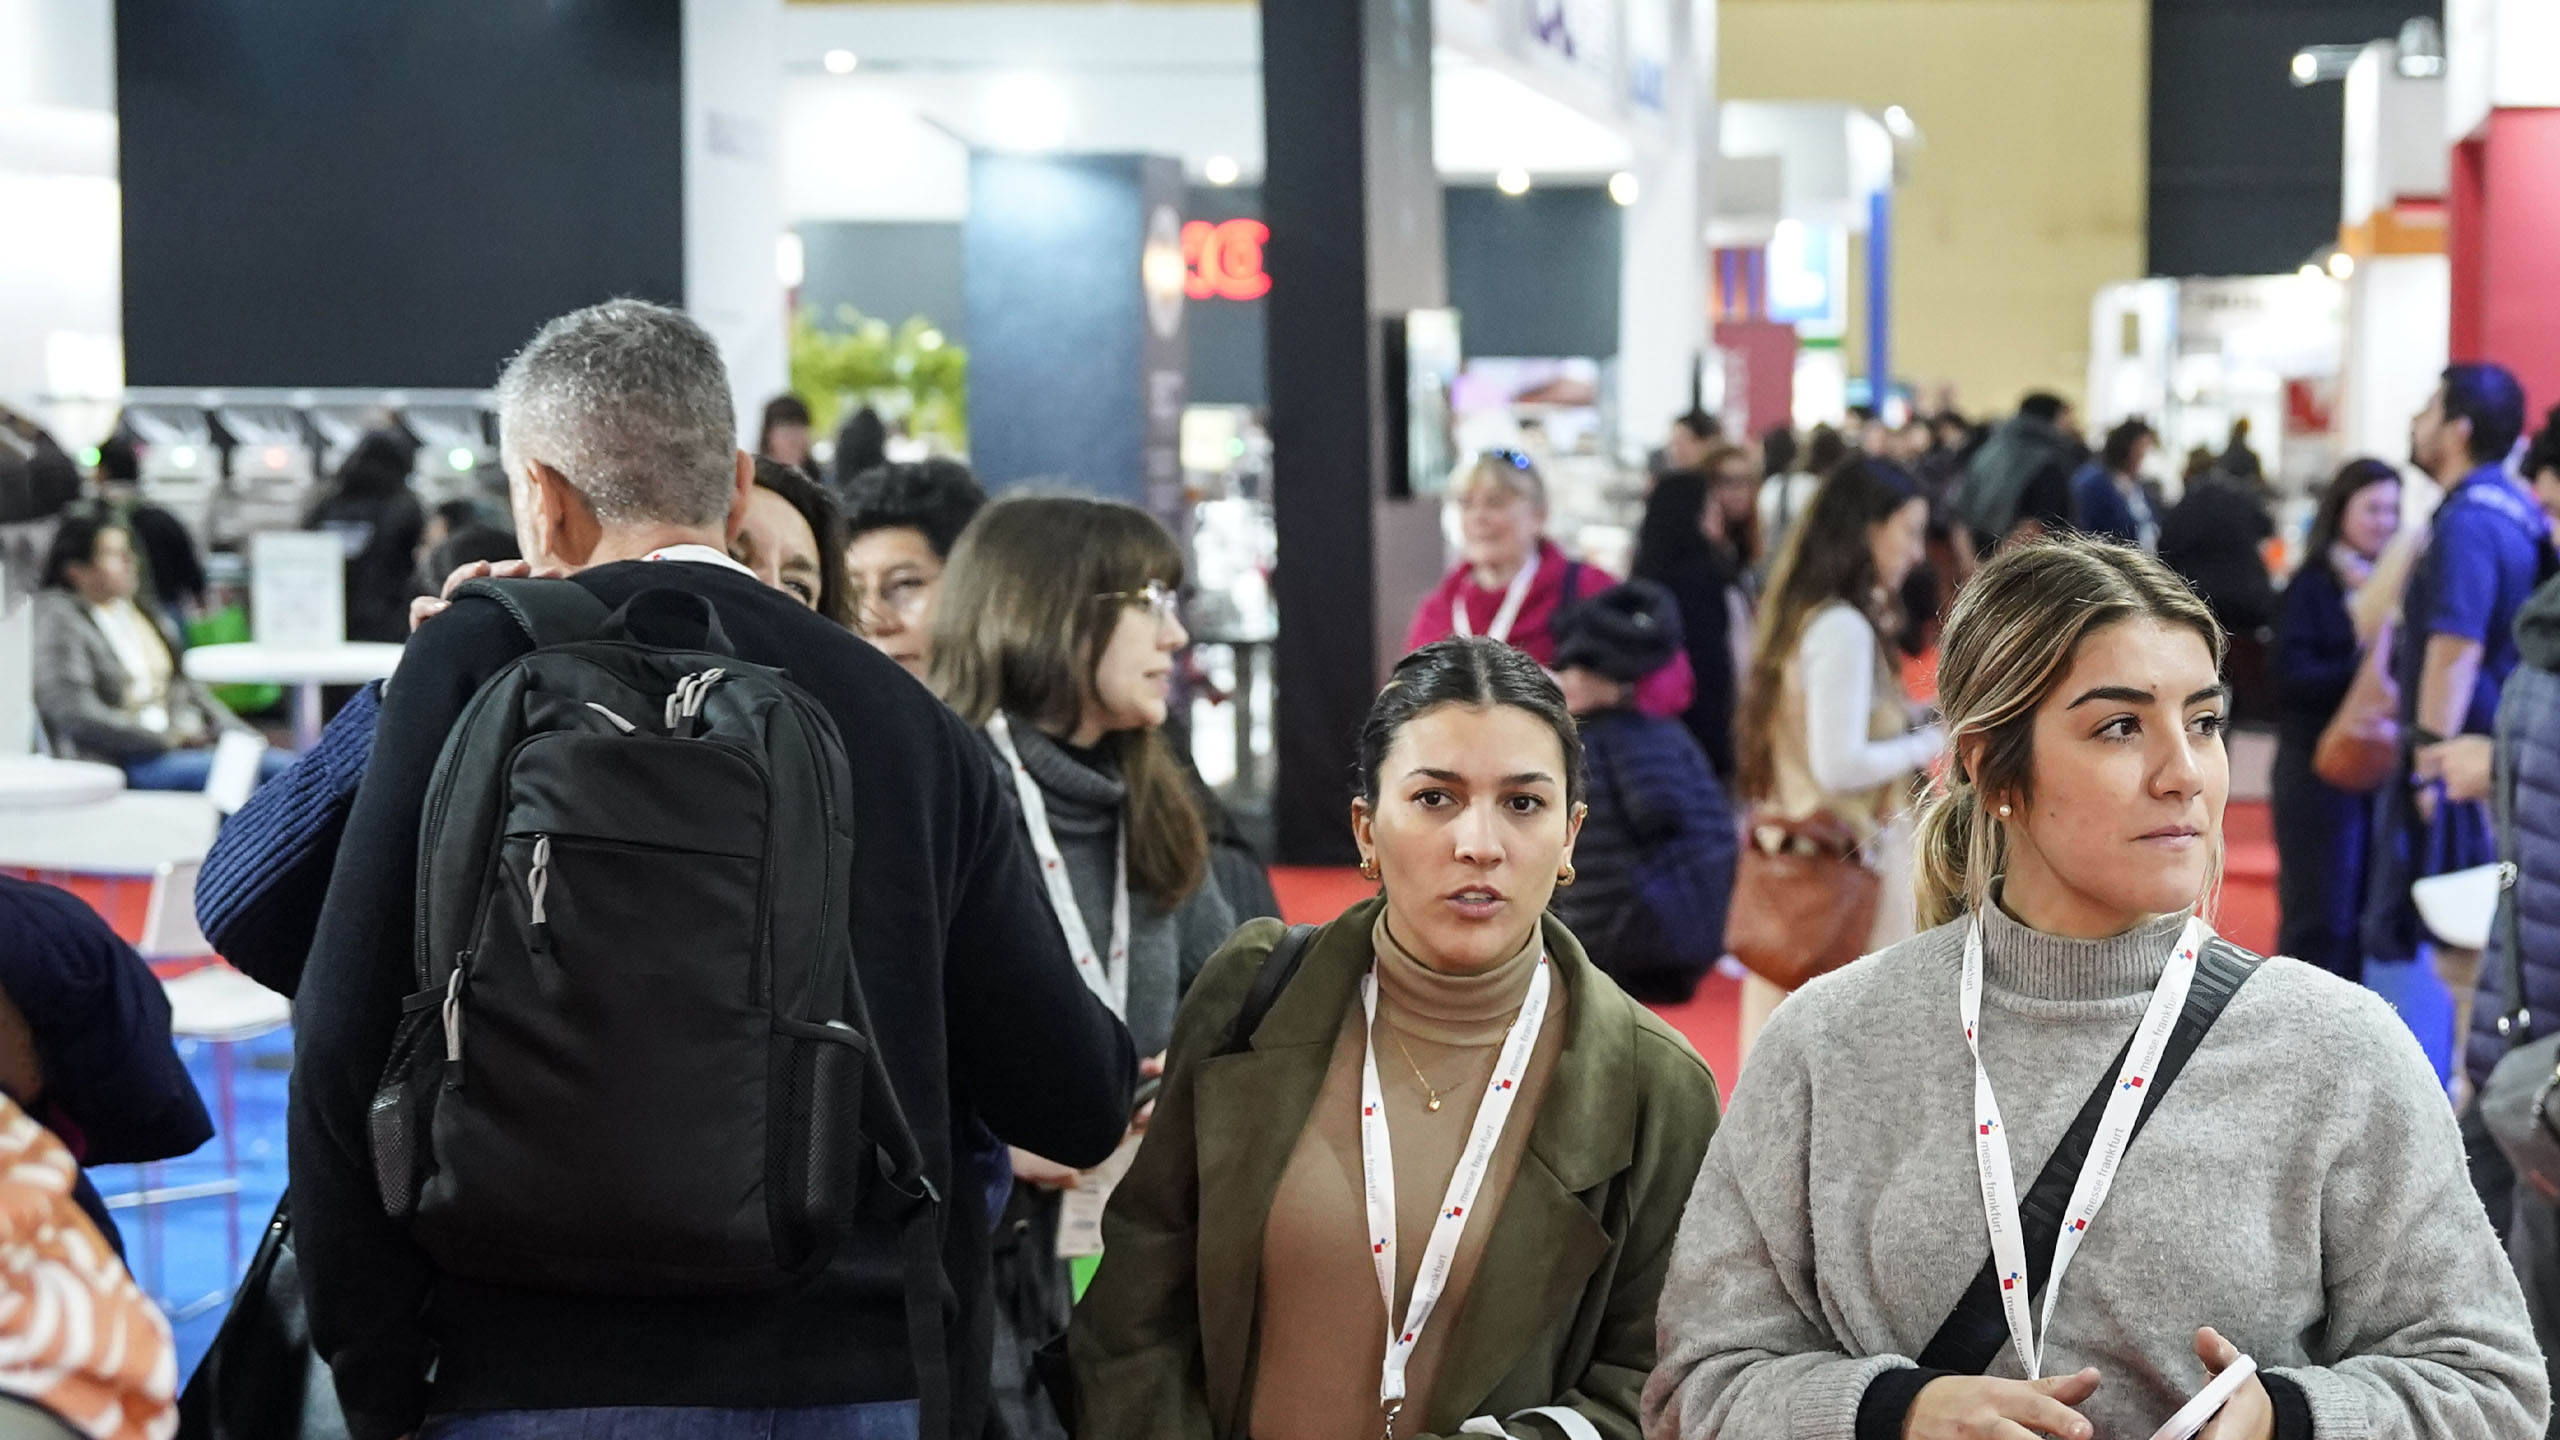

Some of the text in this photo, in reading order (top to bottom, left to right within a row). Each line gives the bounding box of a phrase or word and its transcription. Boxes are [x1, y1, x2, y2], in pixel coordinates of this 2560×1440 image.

[2140, 991, 2179, 1073] messe frankfurt
[1459, 1124, 1496, 1203] messe frankfurt
[1979, 1140, 2003, 1233] messe frankfurt
[2083, 1127, 2125, 1216] messe frankfurt
[1426, 1254, 1448, 1300] frankfurt
[2006, 1295, 2019, 1336] messe
